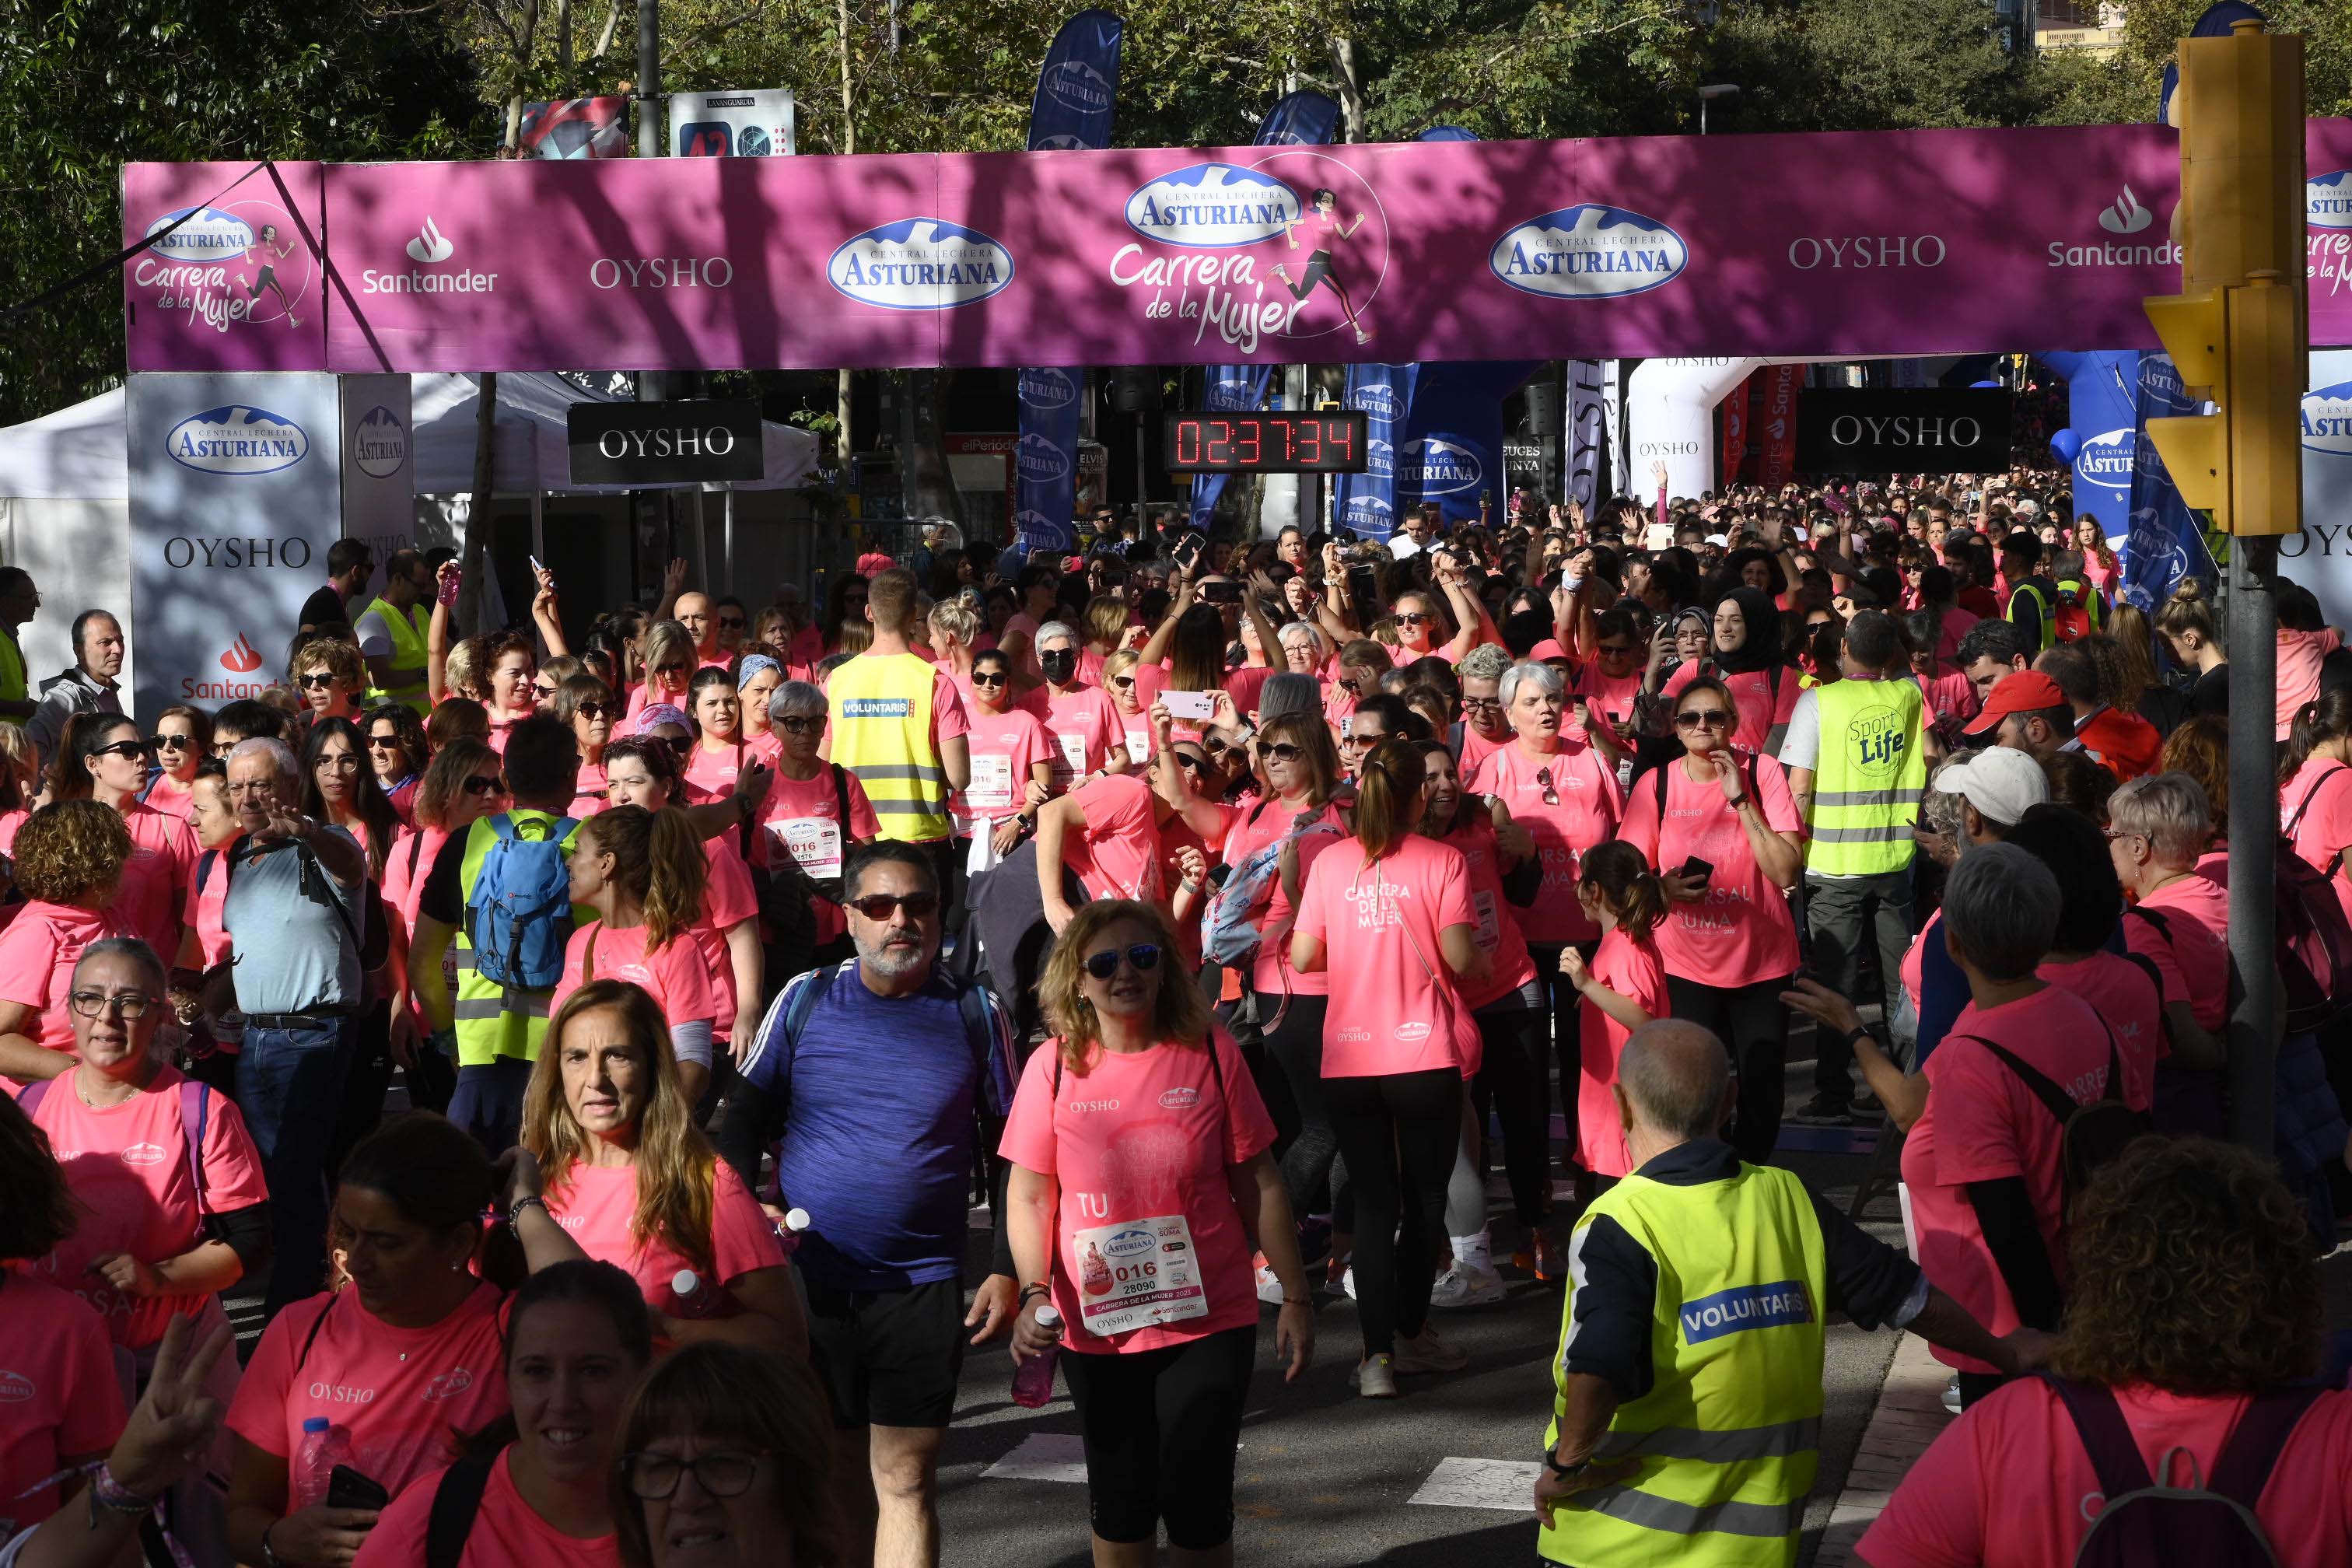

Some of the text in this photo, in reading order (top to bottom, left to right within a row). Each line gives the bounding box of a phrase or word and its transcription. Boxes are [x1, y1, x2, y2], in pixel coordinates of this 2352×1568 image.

[1164, 191, 1222, 201] CENTRAL
[1138, 194, 1289, 227] ASTURIANA
[154, 226, 246, 248] ASTURIANA
[1535, 236, 1666, 247] CENTRAL LECHERA
[870, 249, 995, 258] CENTRAL LECHERA
[1504, 241, 1673, 276] ASTURIANA
[1789, 235, 1945, 269] OYSHO
[135, 257, 226, 288] Carrera
[590, 257, 733, 289] OYSHO
[841, 252, 1000, 287] ASTURIANA
[1109, 243, 1256, 287] Carrera
[2320, 256, 2334, 278] la
[362, 268, 499, 294] Santander
[158, 285, 261, 333] de la Mujer
[1145, 281, 1311, 355] de la Mujer
[598, 425, 735, 459] OYSHO
[1831, 415, 1982, 447] OYSHO
[177, 431, 299, 458] ASTURIANA
[358, 432, 403, 460] ASTURIANA
[1177, 421, 1353, 464] 02:37:34
[1640, 441, 1699, 457] OYSHO
[1080, 453, 1104, 464] ELVIS
[163, 536, 311, 569] OYSHO
[843, 702, 907, 713] VOLUNTARIS
[1850, 711, 1896, 740] Sport
[1859, 729, 1904, 765] Life
[1670, 808, 1703, 817] OYSHO
[791, 842, 816, 852] 016
[1344, 883, 1411, 901] CARRERA
[1358, 912, 1402, 929] MUJER
[1337, 1031, 1370, 1042] OYSHO
[1069, 1099, 1120, 1113] OYSHO
[1160, 1093, 1199, 1106] ASTURIANA
[1076, 1192, 1108, 1219] TU
[1108, 1239, 1153, 1255] ASTURIANA
[1115, 1261, 1157, 1282] 016
[1123, 1280, 1156, 1295] 28090
[1096, 1300, 1129, 1312] CARRERA
[1151, 1291, 1174, 1300] MUJER
[1175, 1289, 1192, 1298] 2023
[1161, 1303, 1198, 1314] Santander
[1097, 1314, 1133, 1330] OYSHO
[310, 1382, 374, 1404] OYSHO
